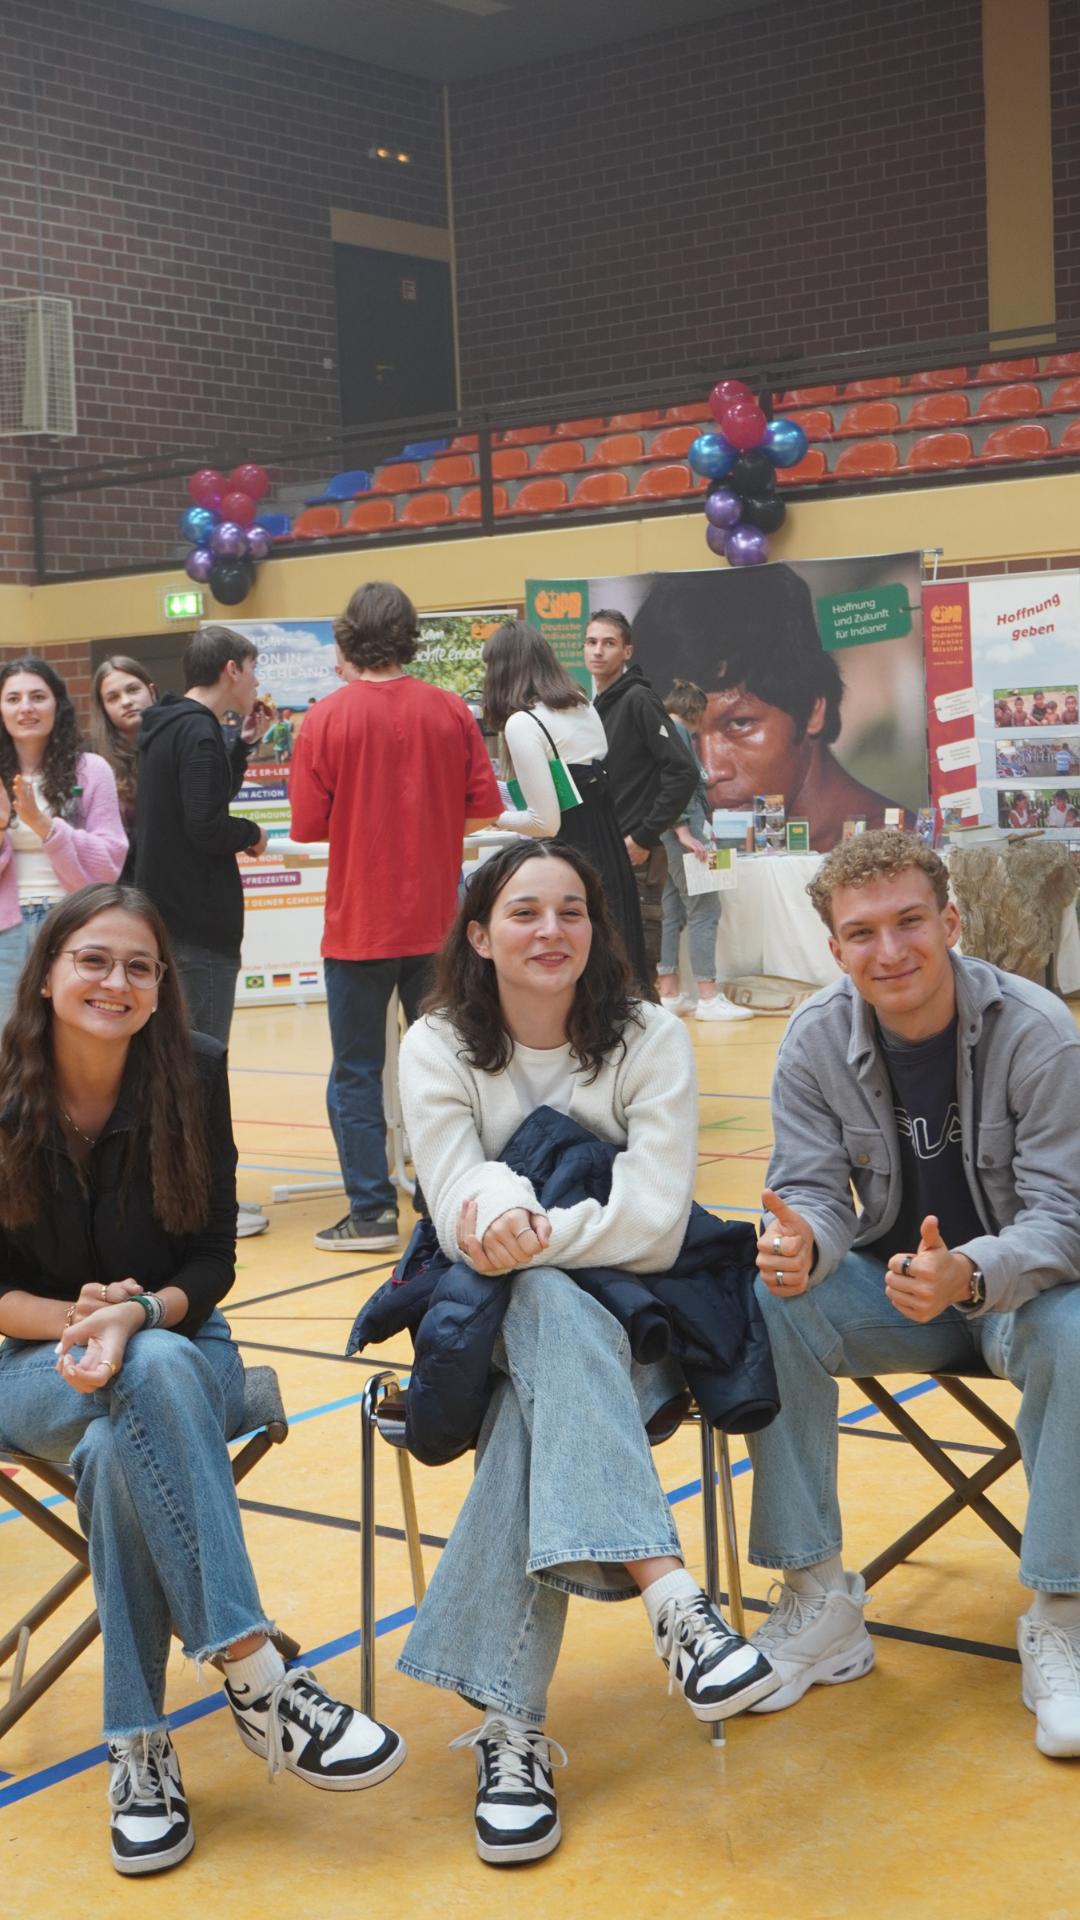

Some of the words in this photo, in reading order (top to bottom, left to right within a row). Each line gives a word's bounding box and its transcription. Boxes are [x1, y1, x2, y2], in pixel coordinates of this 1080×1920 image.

[832, 599, 876, 614] Hoffnung
[996, 593, 1061, 626] Hoffnung
[834, 616, 852, 627] und
[854, 608, 889, 623] Zukunft
[543, 633, 582, 641] ndianer
[835, 630, 849, 639] für
[850, 623, 887, 637] Indianer
[1012, 623, 1055, 641] geben
[255, 665, 330, 681] SCHLAND
[260, 767, 291, 776] ER-LEB
[250, 789, 285, 799] ACTION
[251, 898, 284, 908] DEINER
[286, 894, 326, 905] GEMEIND
